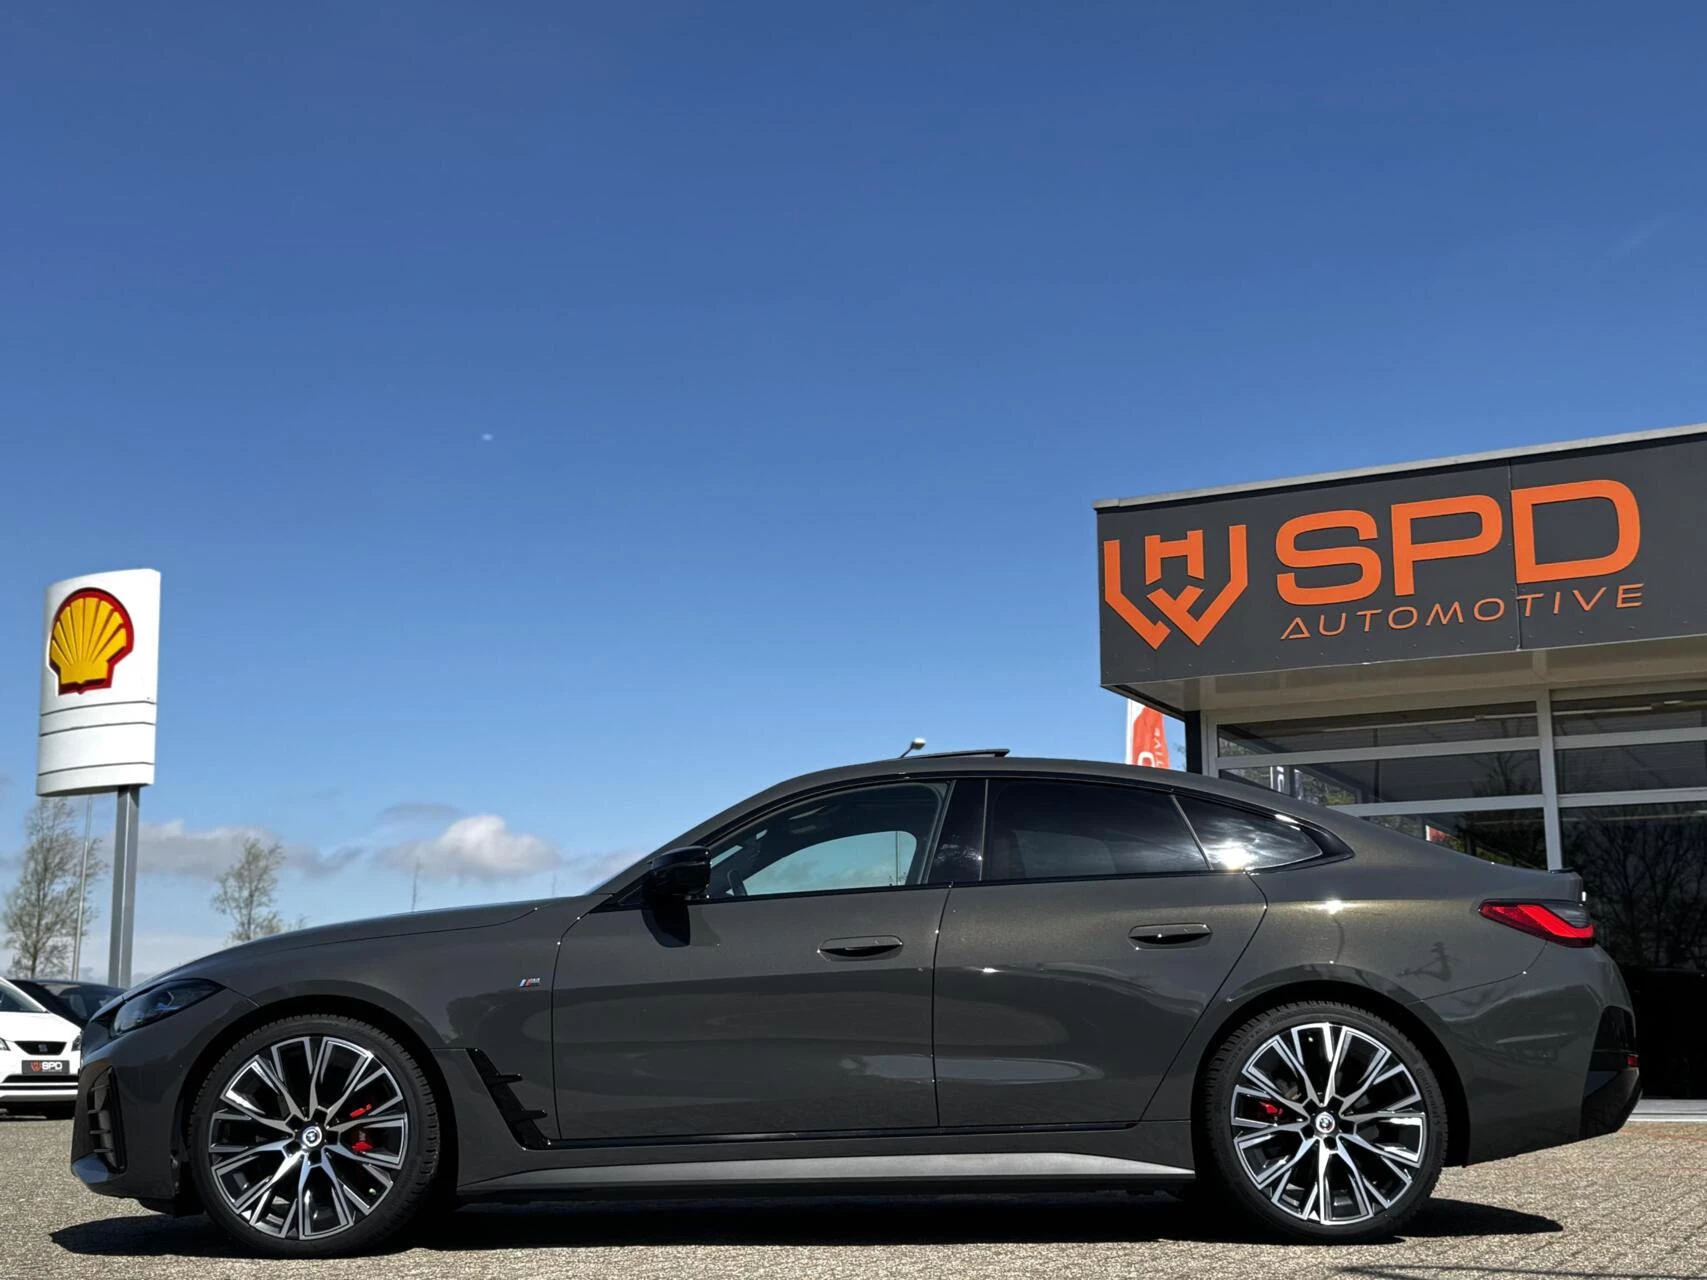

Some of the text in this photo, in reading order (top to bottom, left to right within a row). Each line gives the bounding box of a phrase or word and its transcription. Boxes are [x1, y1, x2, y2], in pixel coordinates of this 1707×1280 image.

[1276, 480, 1640, 605] SPD
[1281, 584, 1644, 639] AUTOMOTIVE
[42, 1061, 62, 1070] SPD
